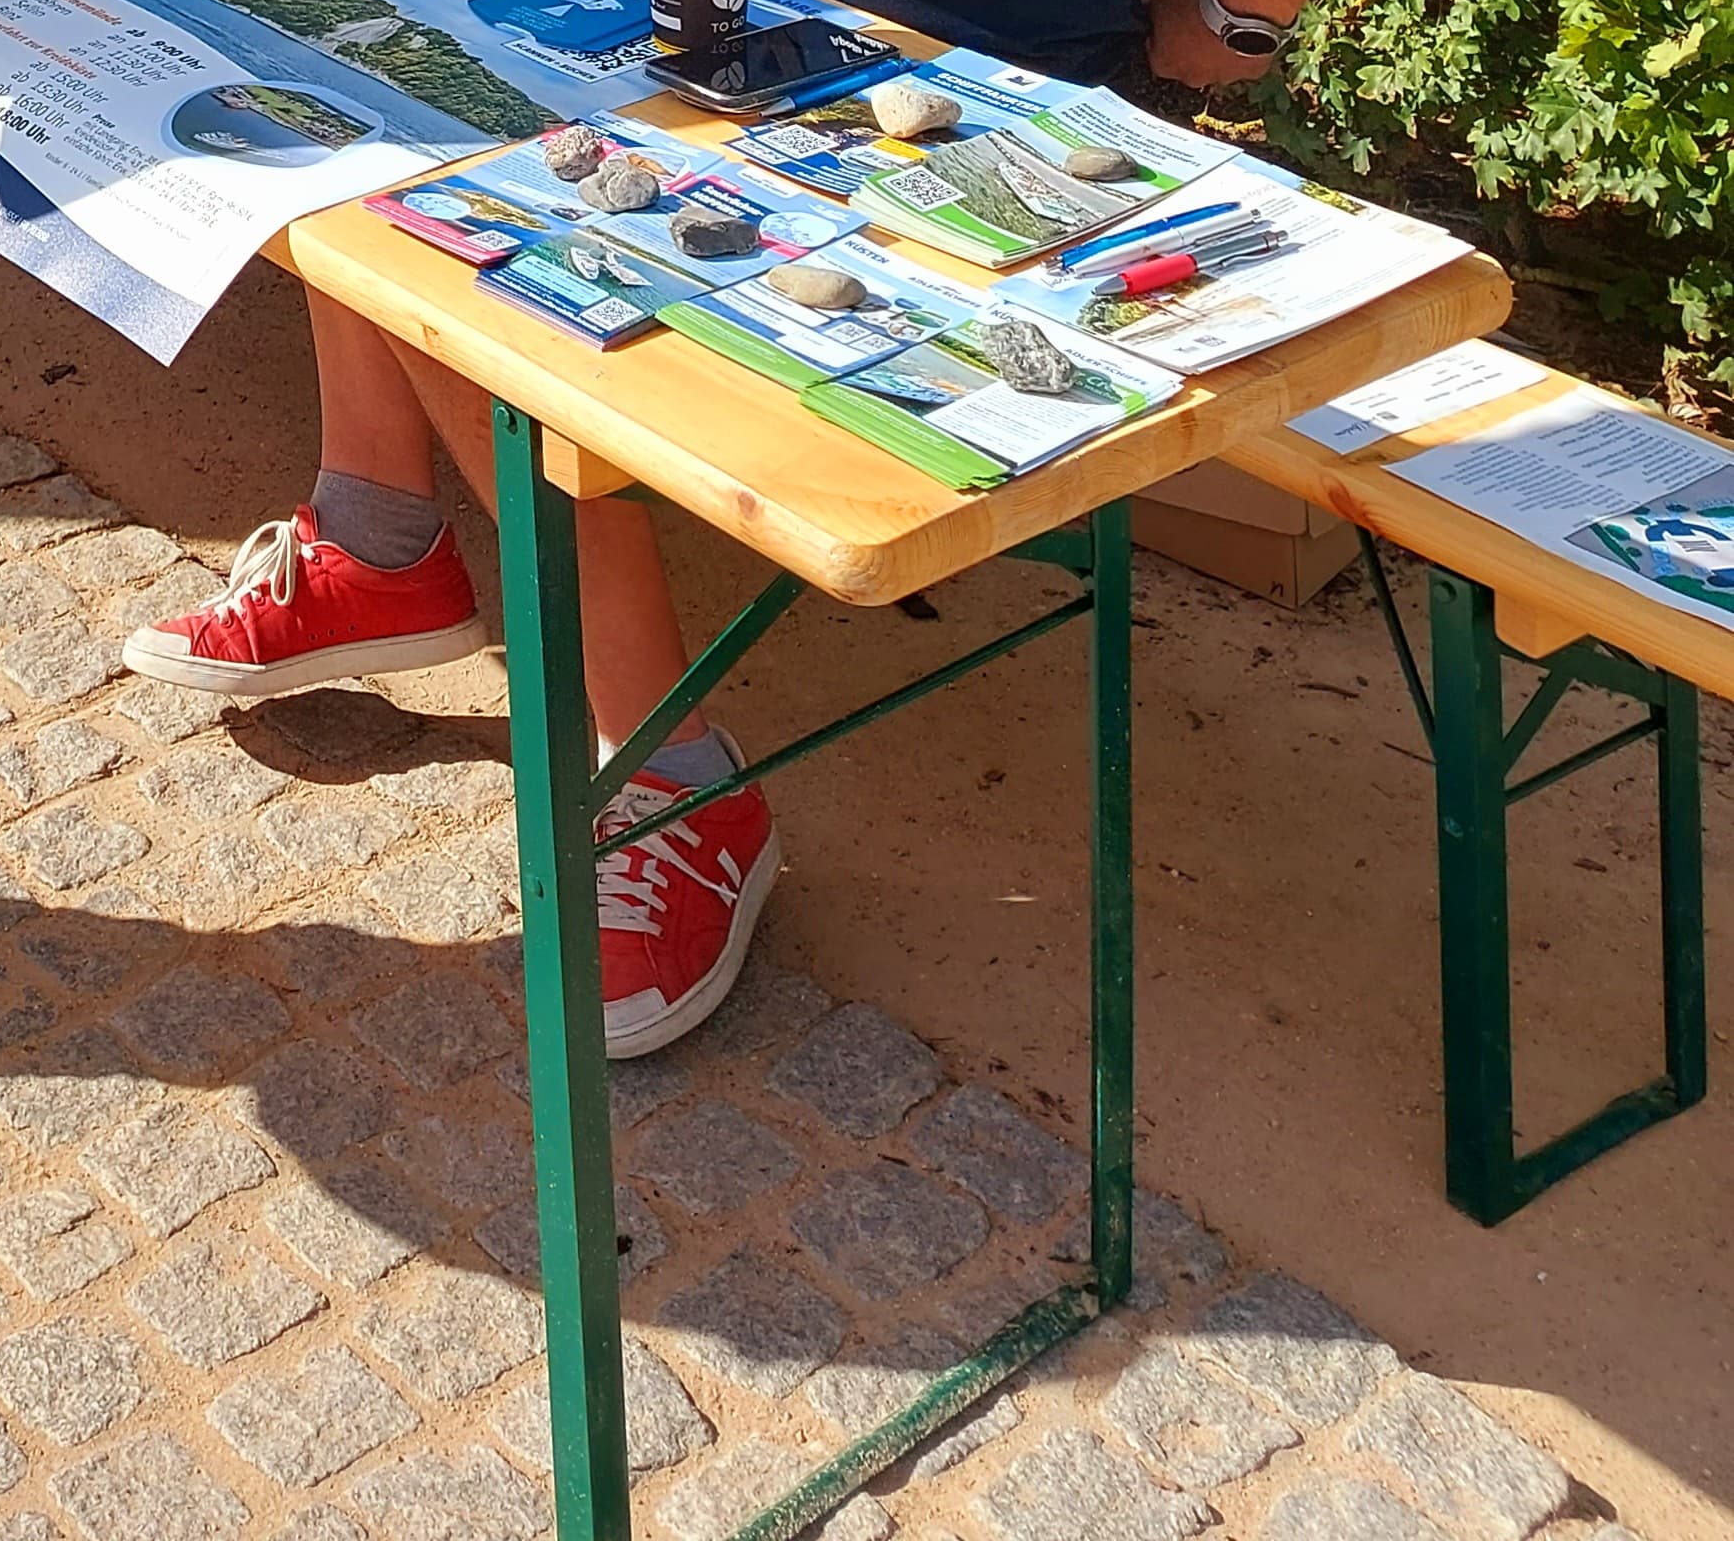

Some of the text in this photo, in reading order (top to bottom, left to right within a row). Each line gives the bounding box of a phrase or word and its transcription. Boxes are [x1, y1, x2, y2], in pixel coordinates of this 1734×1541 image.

[12, 0, 169, 84] Sellin an 11:30 Uhr
[24, 37, 46, 52] zur
[710, 16, 746, 35] TO GO
[67, 45, 88, 58] an
[88, 54, 128, 78] 12:30
[119, 71, 149, 90] Uhr
[106, 34, 127, 45] an
[127, 43, 166, 65] 11:00
[159, 60, 189, 78] Uhr
[125, 27, 147, 39] ab
[150, 39, 187, 61] 9:00
[178, 52, 209, 71] Uhr
[10, 69, 30, 85] ab
[29, 79, 69, 104] 15:30
[62, 97, 91, 117] Uhr
[29, 59, 49, 73] ab
[49, 69, 88, 93] 15:00
[81, 86, 111, 105] Uhr
[11, 92, 50, 119] 16:00
[42, 111, 72, 132] Uhr
[24, 125, 54, 146] Uhr
[844, 239, 890, 264] KÜSTEN
[1065, 348, 1149, 386] ADLER-SCHIFFE
